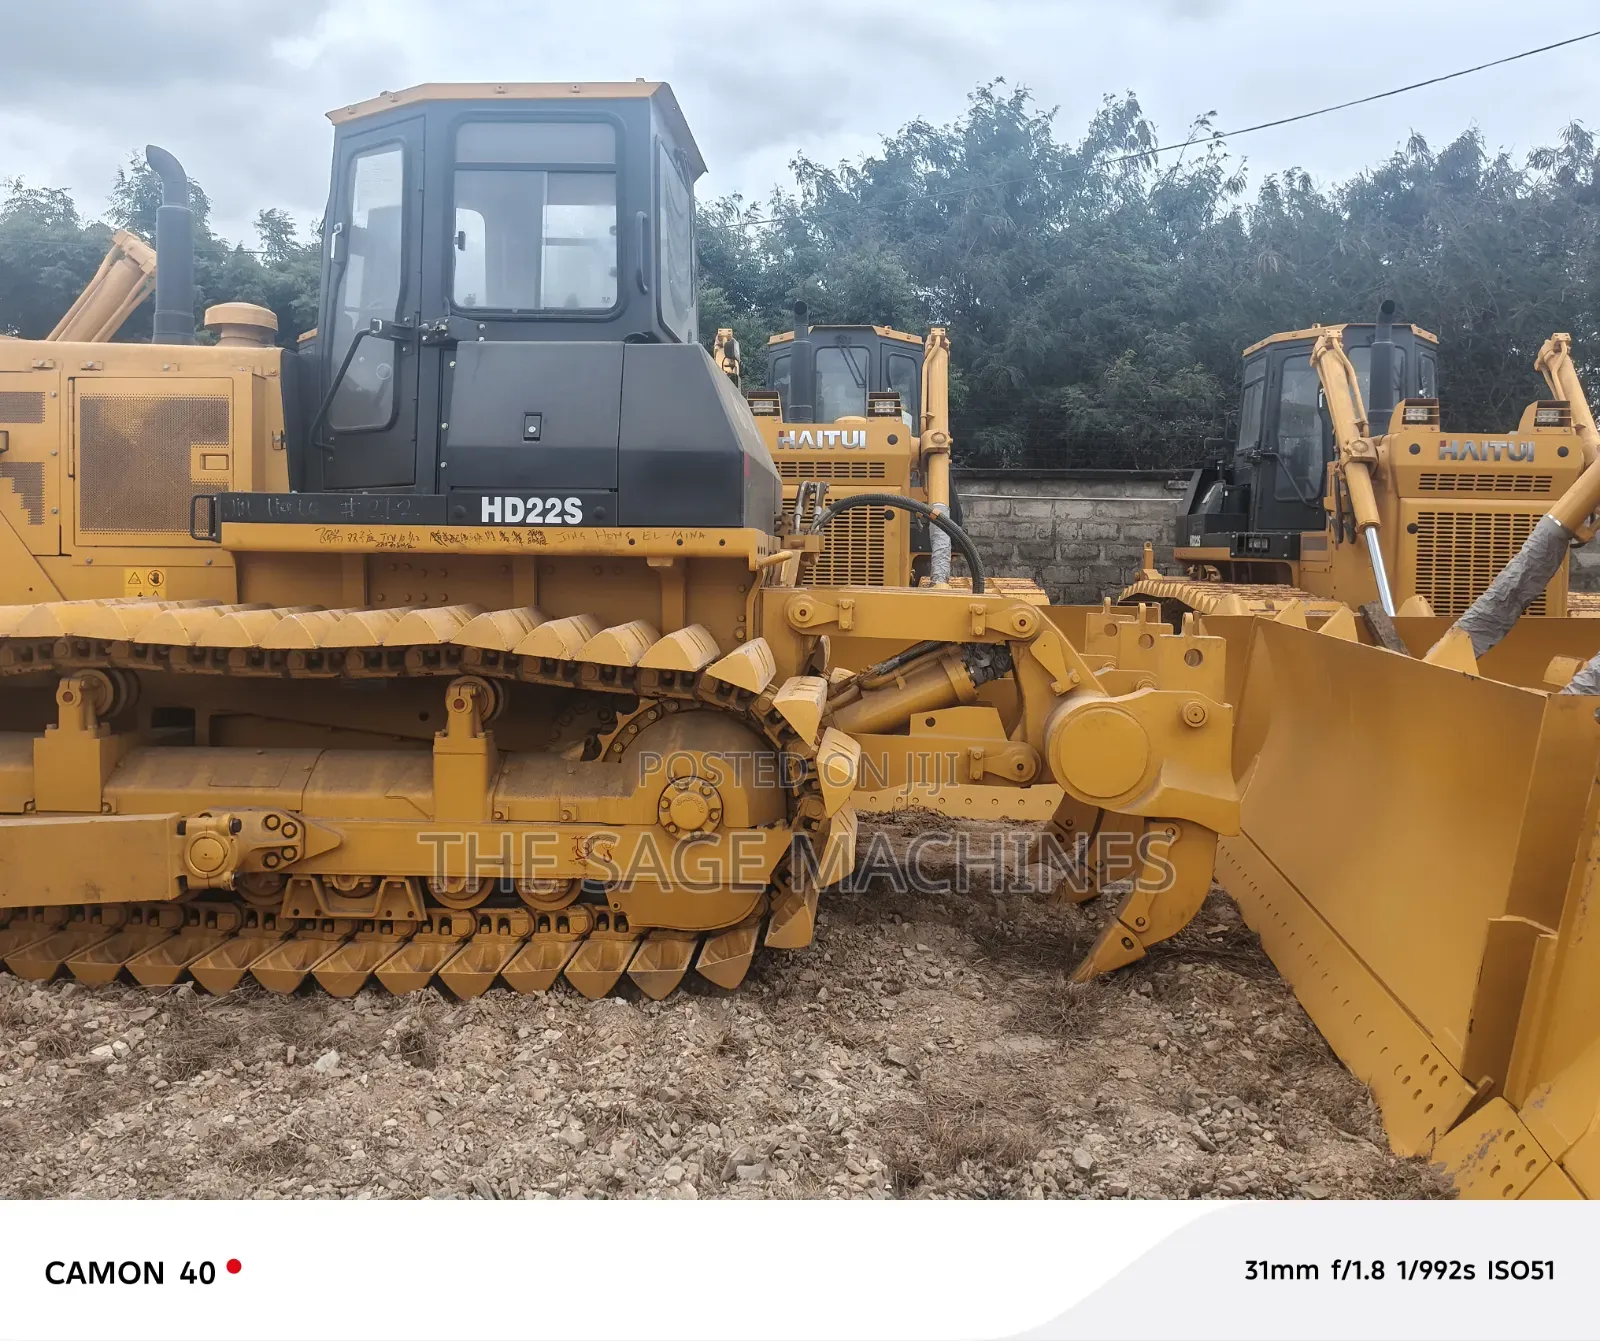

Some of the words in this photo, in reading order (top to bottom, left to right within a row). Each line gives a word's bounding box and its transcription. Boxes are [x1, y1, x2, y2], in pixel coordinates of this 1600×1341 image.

[777, 430, 867, 450] HAITUI
[1438, 439, 1536, 462] HAITUI
[481, 496, 583, 524] HD22S
